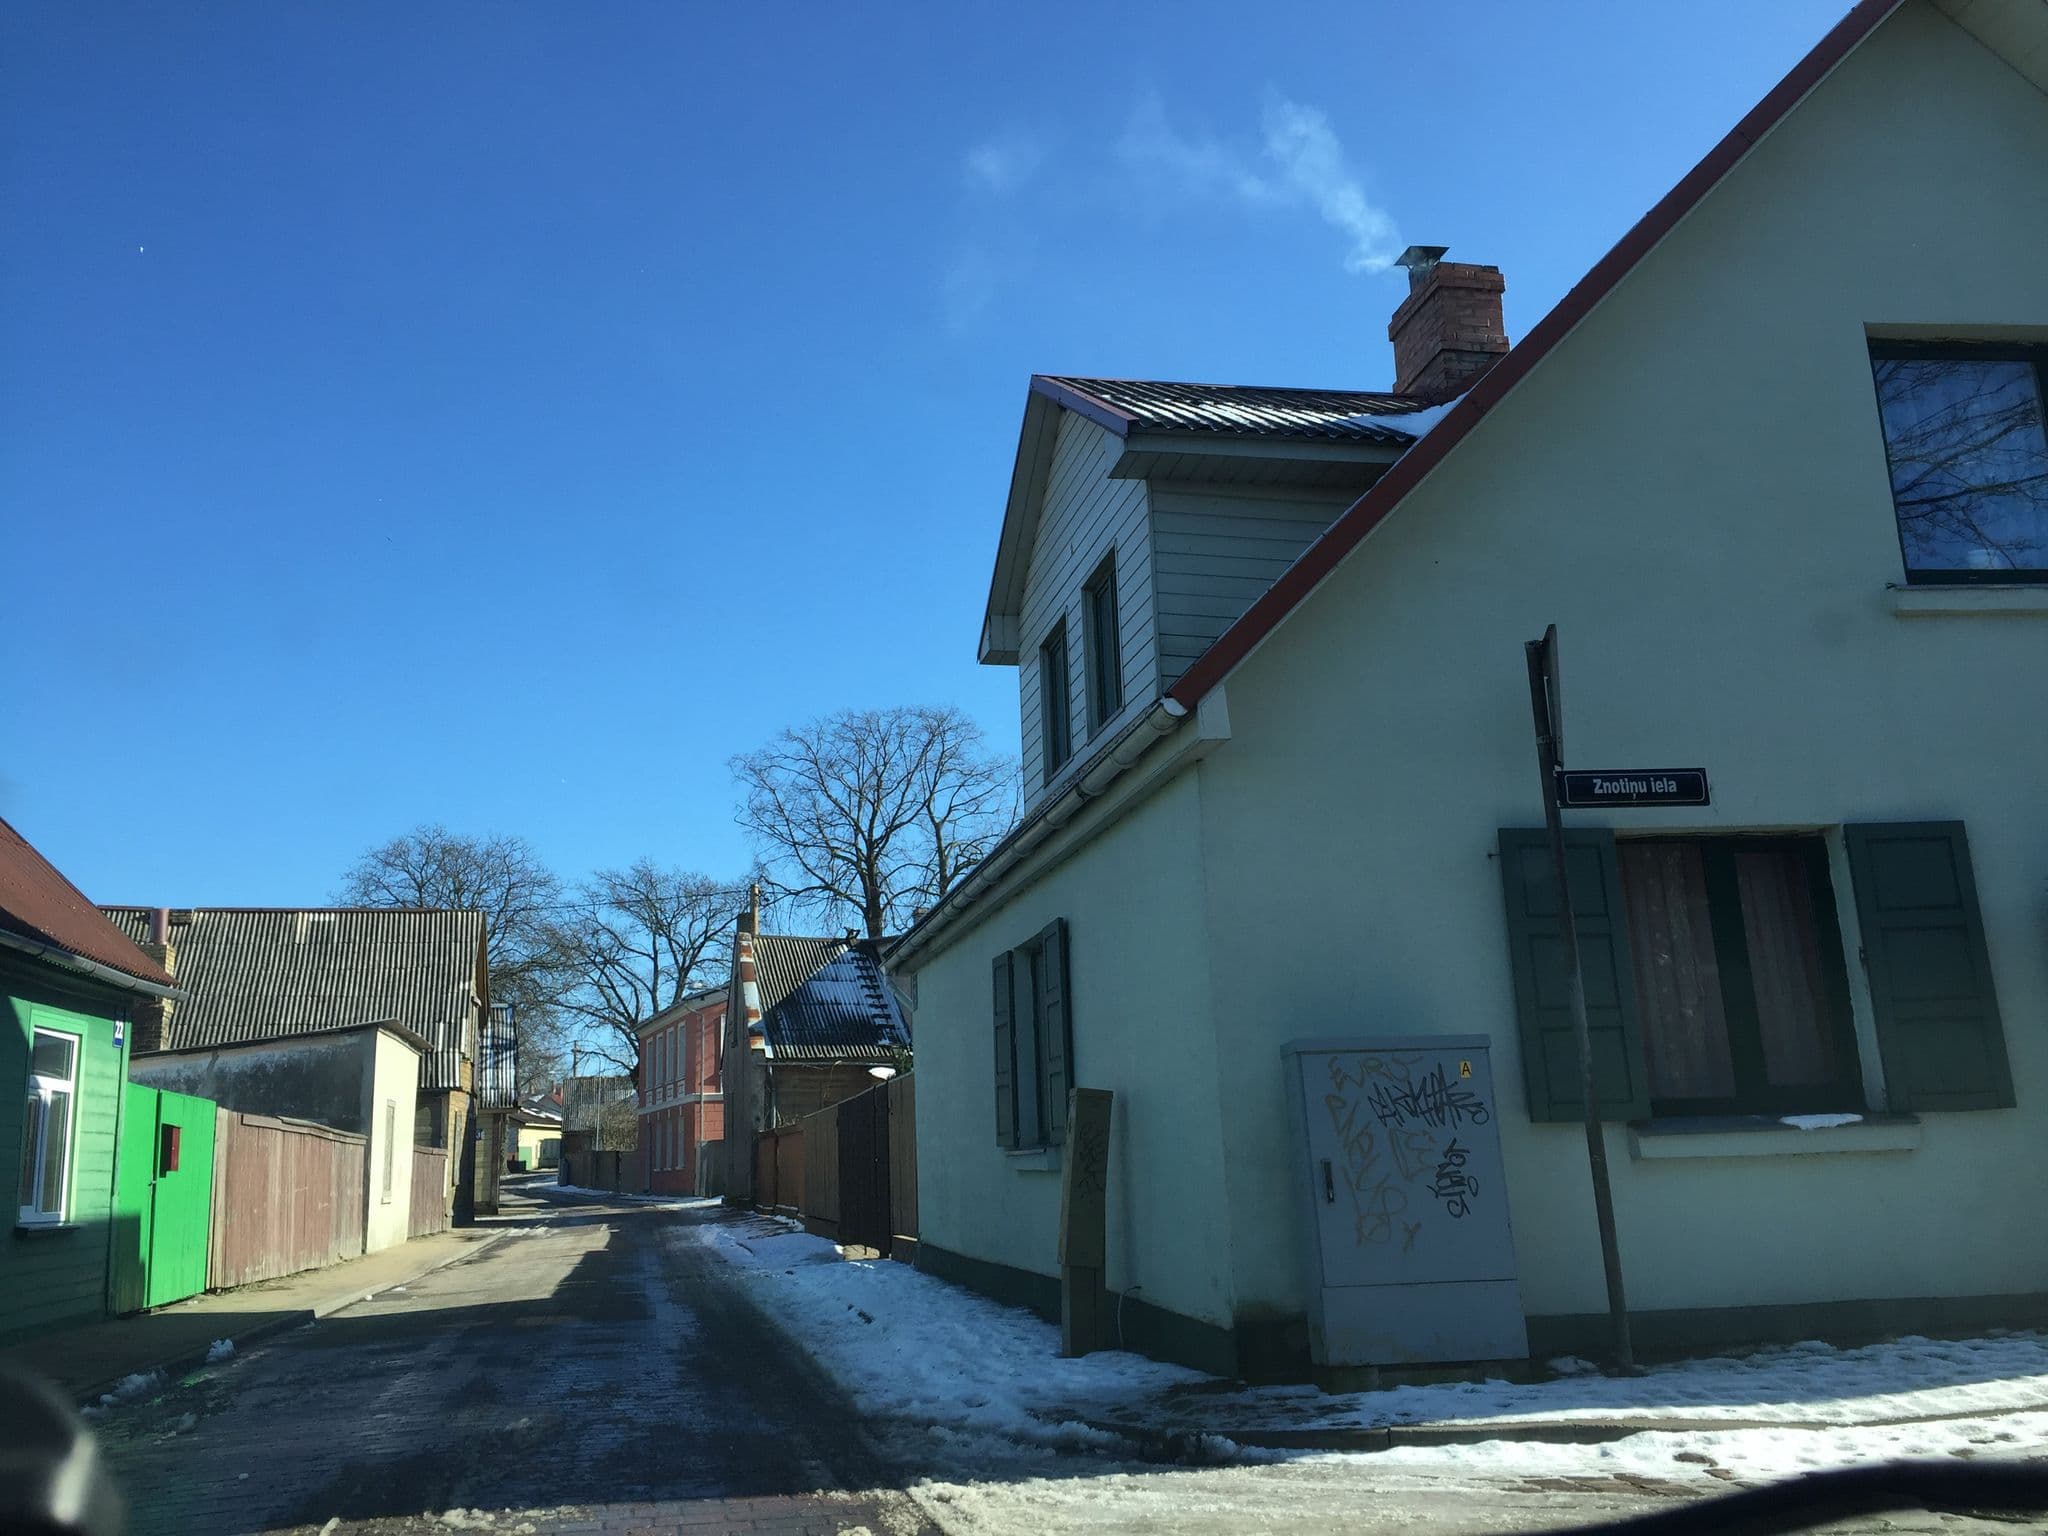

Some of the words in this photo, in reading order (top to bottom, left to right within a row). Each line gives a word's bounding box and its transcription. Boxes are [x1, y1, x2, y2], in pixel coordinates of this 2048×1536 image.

[1592, 778, 1647, 800] Znotiņu
[1651, 776, 1678, 793] iela
[114, 1020, 124, 1039] 22
[1461, 1062, 1471, 1076] A
